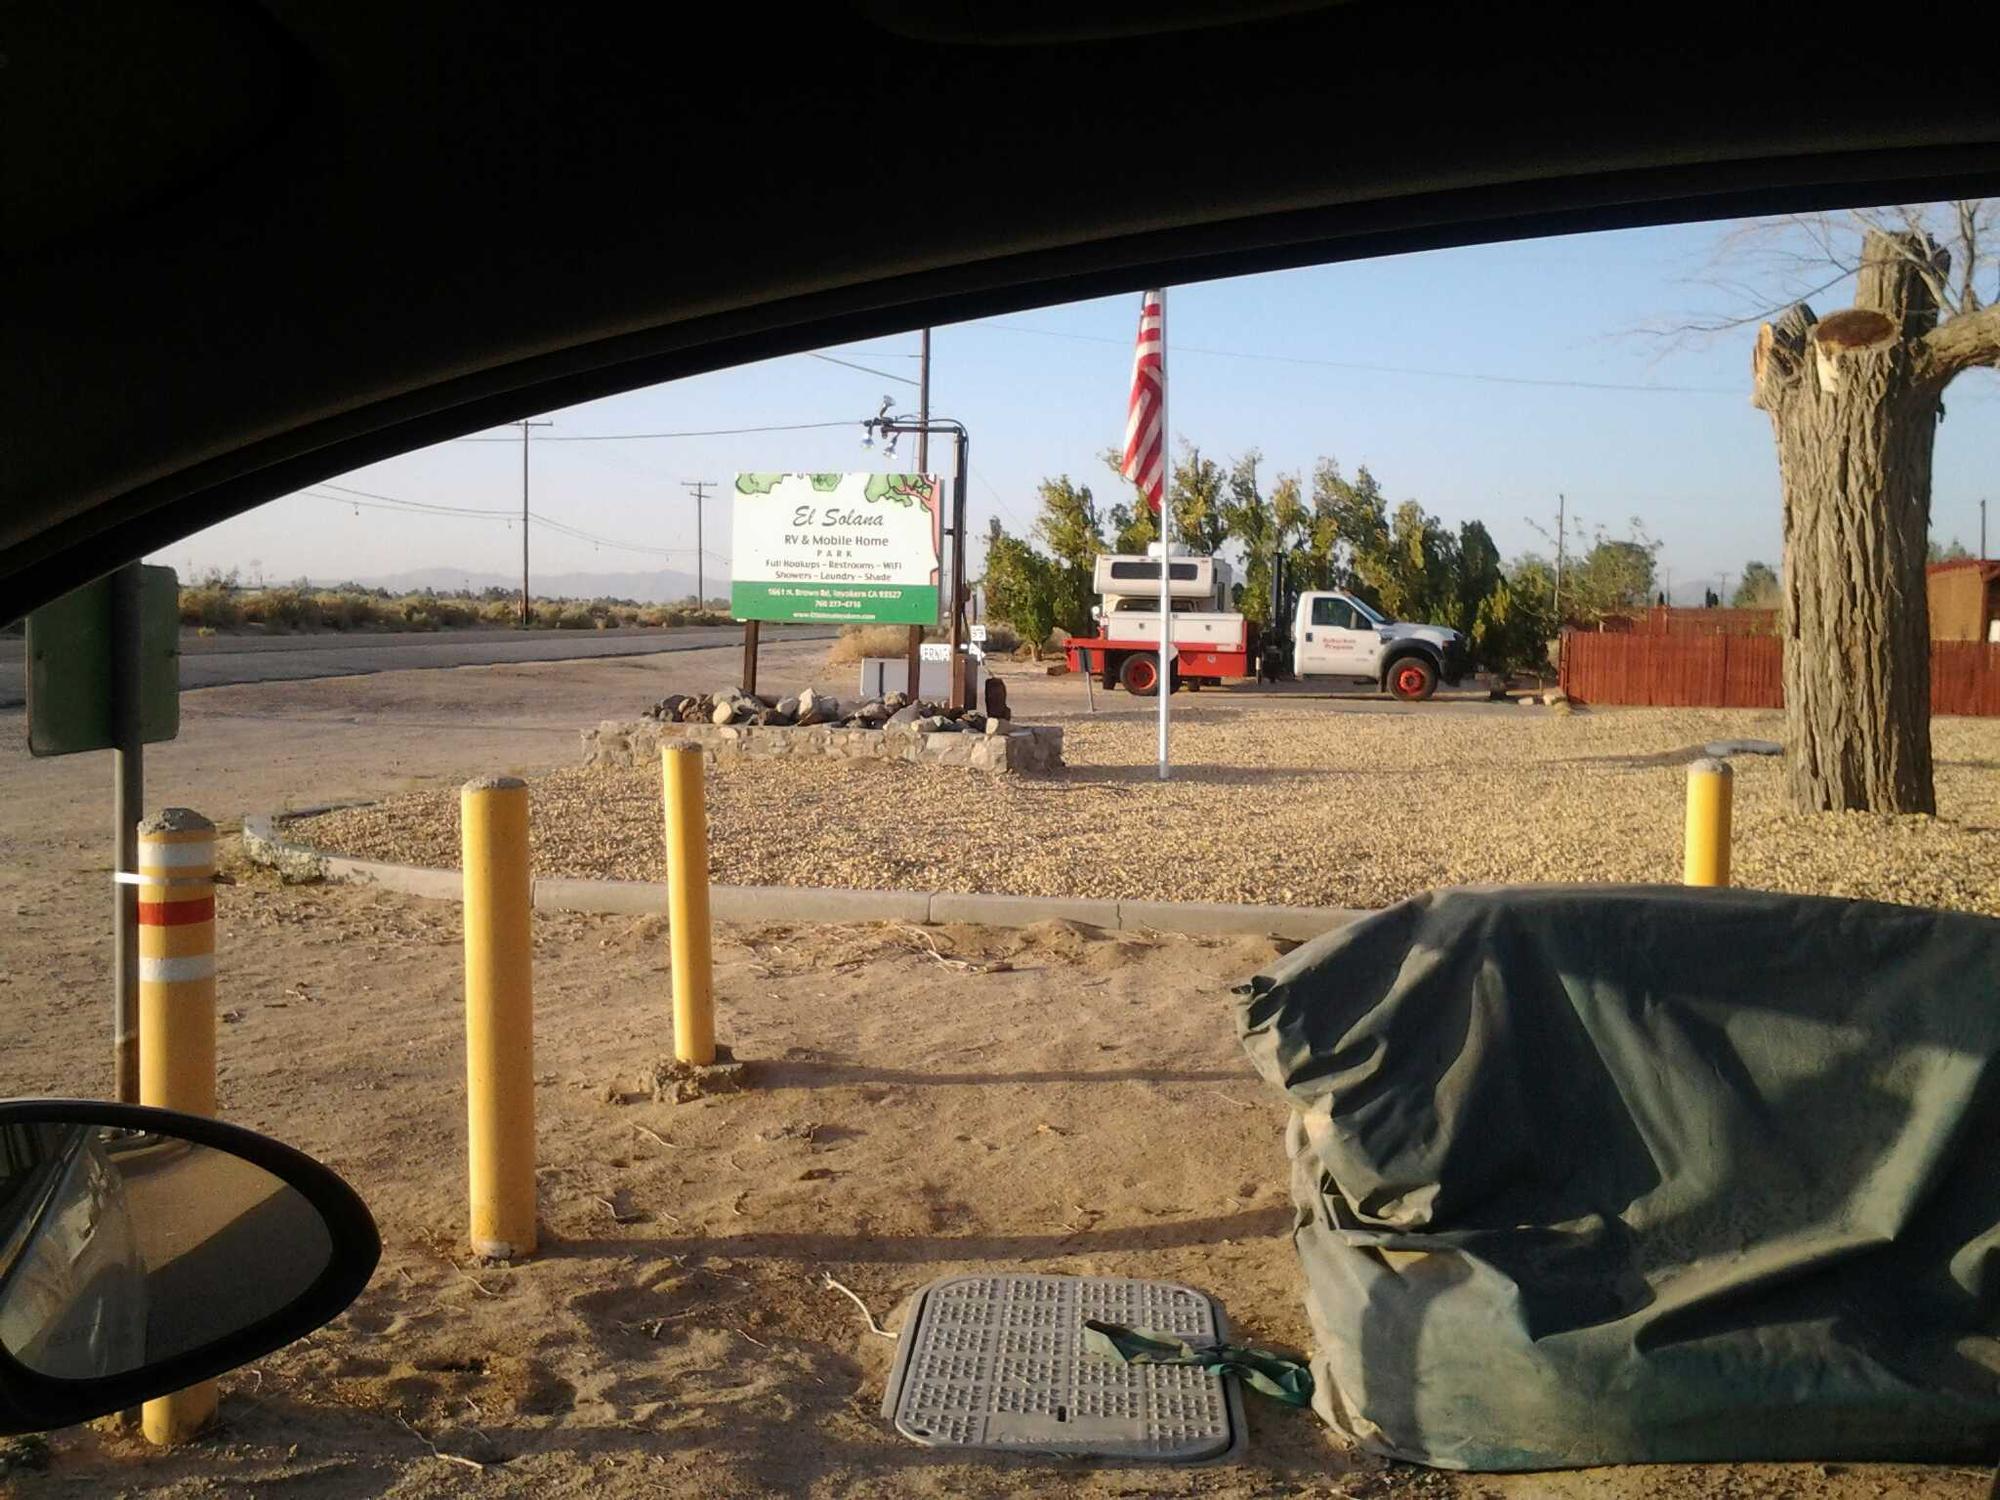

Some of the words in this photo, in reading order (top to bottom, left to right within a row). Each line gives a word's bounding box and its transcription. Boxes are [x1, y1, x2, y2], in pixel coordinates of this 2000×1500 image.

[793, 506, 815, 527] El
[822, 509, 884, 527] Solana
[784, 534, 799, 547] RV
[801, 535, 810, 547] &
[812, 534, 853, 547] Mobile
[855, 537, 889, 547] Home
[765, 558, 781, 568] Full
[783, 560, 820, 570] Hookups
[828, 561, 875, 570] Restrooms
[775, 571, 813, 581] Showers
[820, 571, 857, 582] Laundry
[865, 573, 892, 581] Shade
[867, 590, 878, 599] CA
